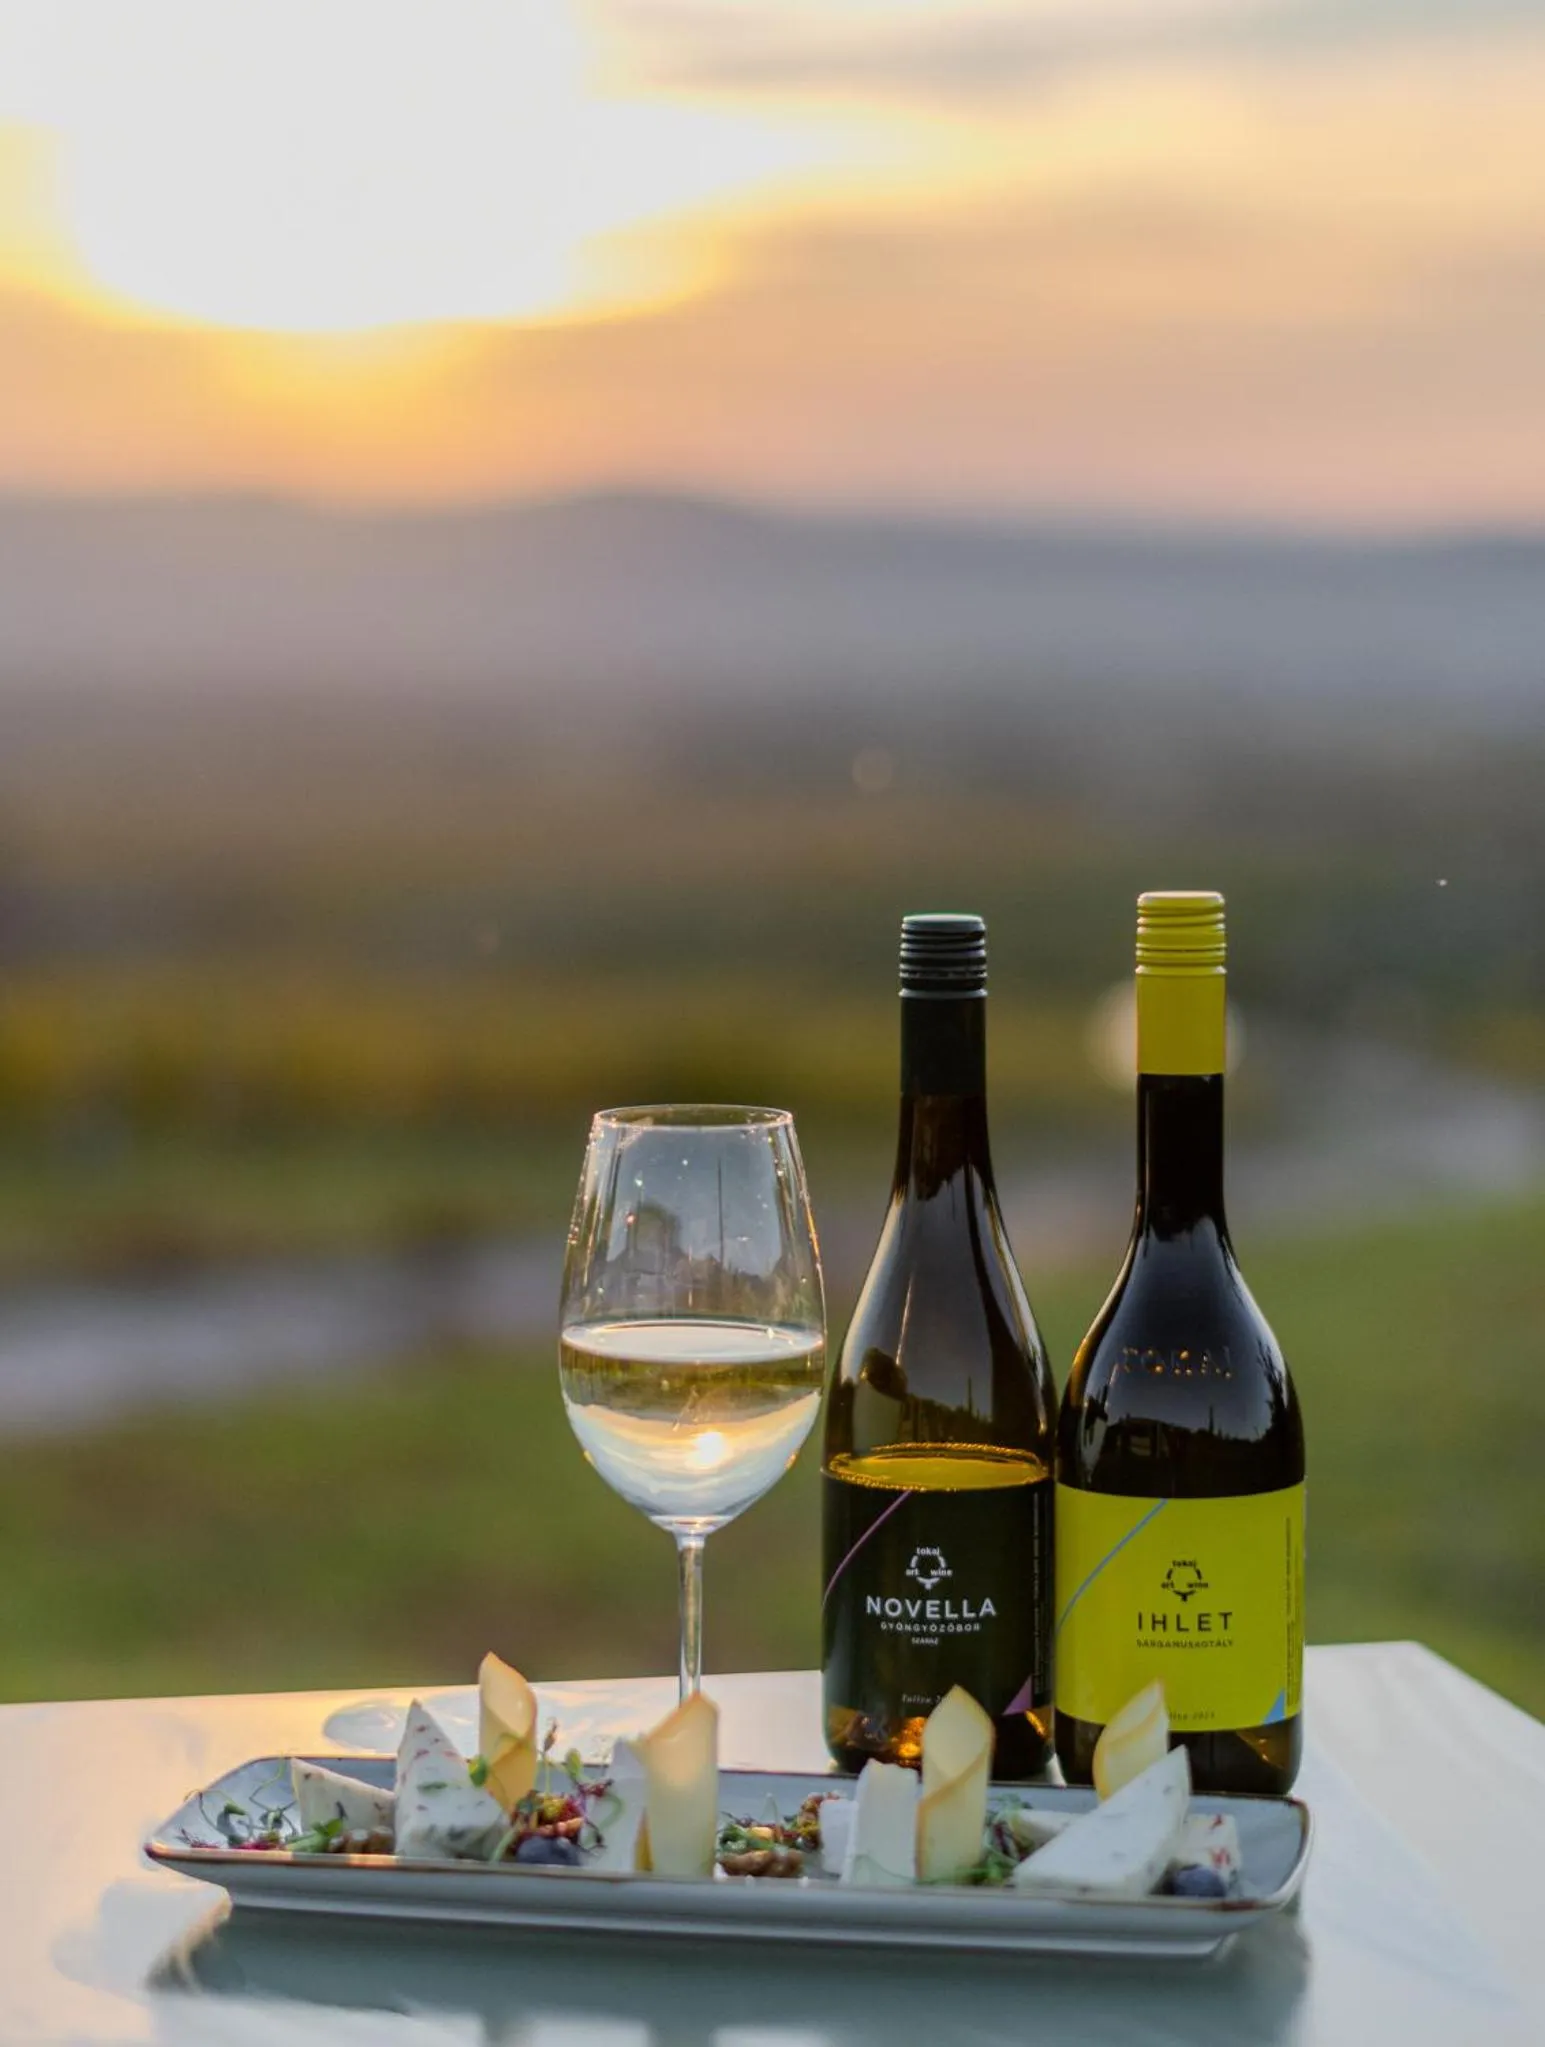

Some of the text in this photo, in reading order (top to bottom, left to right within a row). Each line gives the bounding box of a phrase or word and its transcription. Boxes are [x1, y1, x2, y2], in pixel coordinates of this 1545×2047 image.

[916, 1546, 940, 1556] tokaj
[905, 1568, 952, 1576] art wine
[866, 1595, 997, 1619] NOVELLA
[1137, 1611, 1233, 1632] IHLET
